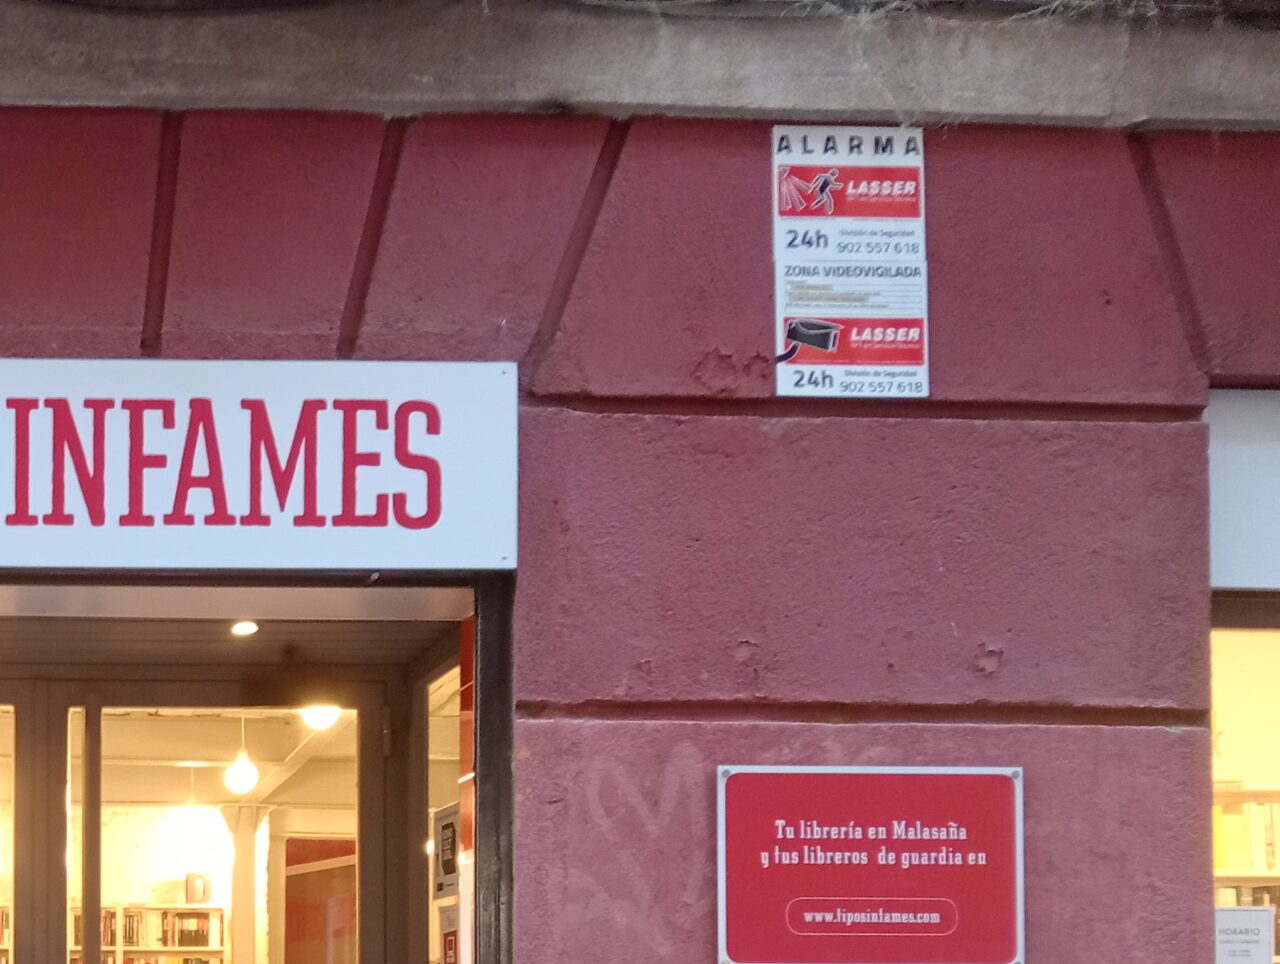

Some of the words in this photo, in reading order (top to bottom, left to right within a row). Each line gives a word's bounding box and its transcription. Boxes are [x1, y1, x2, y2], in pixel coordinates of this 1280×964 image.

[776, 134, 921, 155] ALARMA
[845, 180, 917, 195] LASSER
[785, 228, 829, 248] 24h
[836, 241, 862, 254] 902
[865, 241, 891, 254] 557
[894, 241, 920, 254] 618
[784, 265, 820, 277] ZONA
[823, 265, 922, 278] VIDEOVIGILADA
[850, 327, 920, 341] LASSER
[793, 369, 834, 388] 24h
[839, 381, 865, 393] 902
[868, 381, 893, 393] 557
[896, 381, 924, 393] 618
[4, 396, 443, 530] INFAMES
[775, 819, 795, 839] Tu
[799, 820, 863, 840] librería
[868, 825, 887, 840] en
[891, 820, 967, 840] Malasaña
[760, 850, 770, 868] y
[774, 845, 799, 864] tus
[803, 845, 868, 865] libreros
[877, 846, 896, 865] de
[901, 846, 963, 869] guardia
[967, 851, 987, 865] en
[803, 908, 941, 926] www.tiposinfames.com
[1218, 928, 1261, 936] HORARIO
